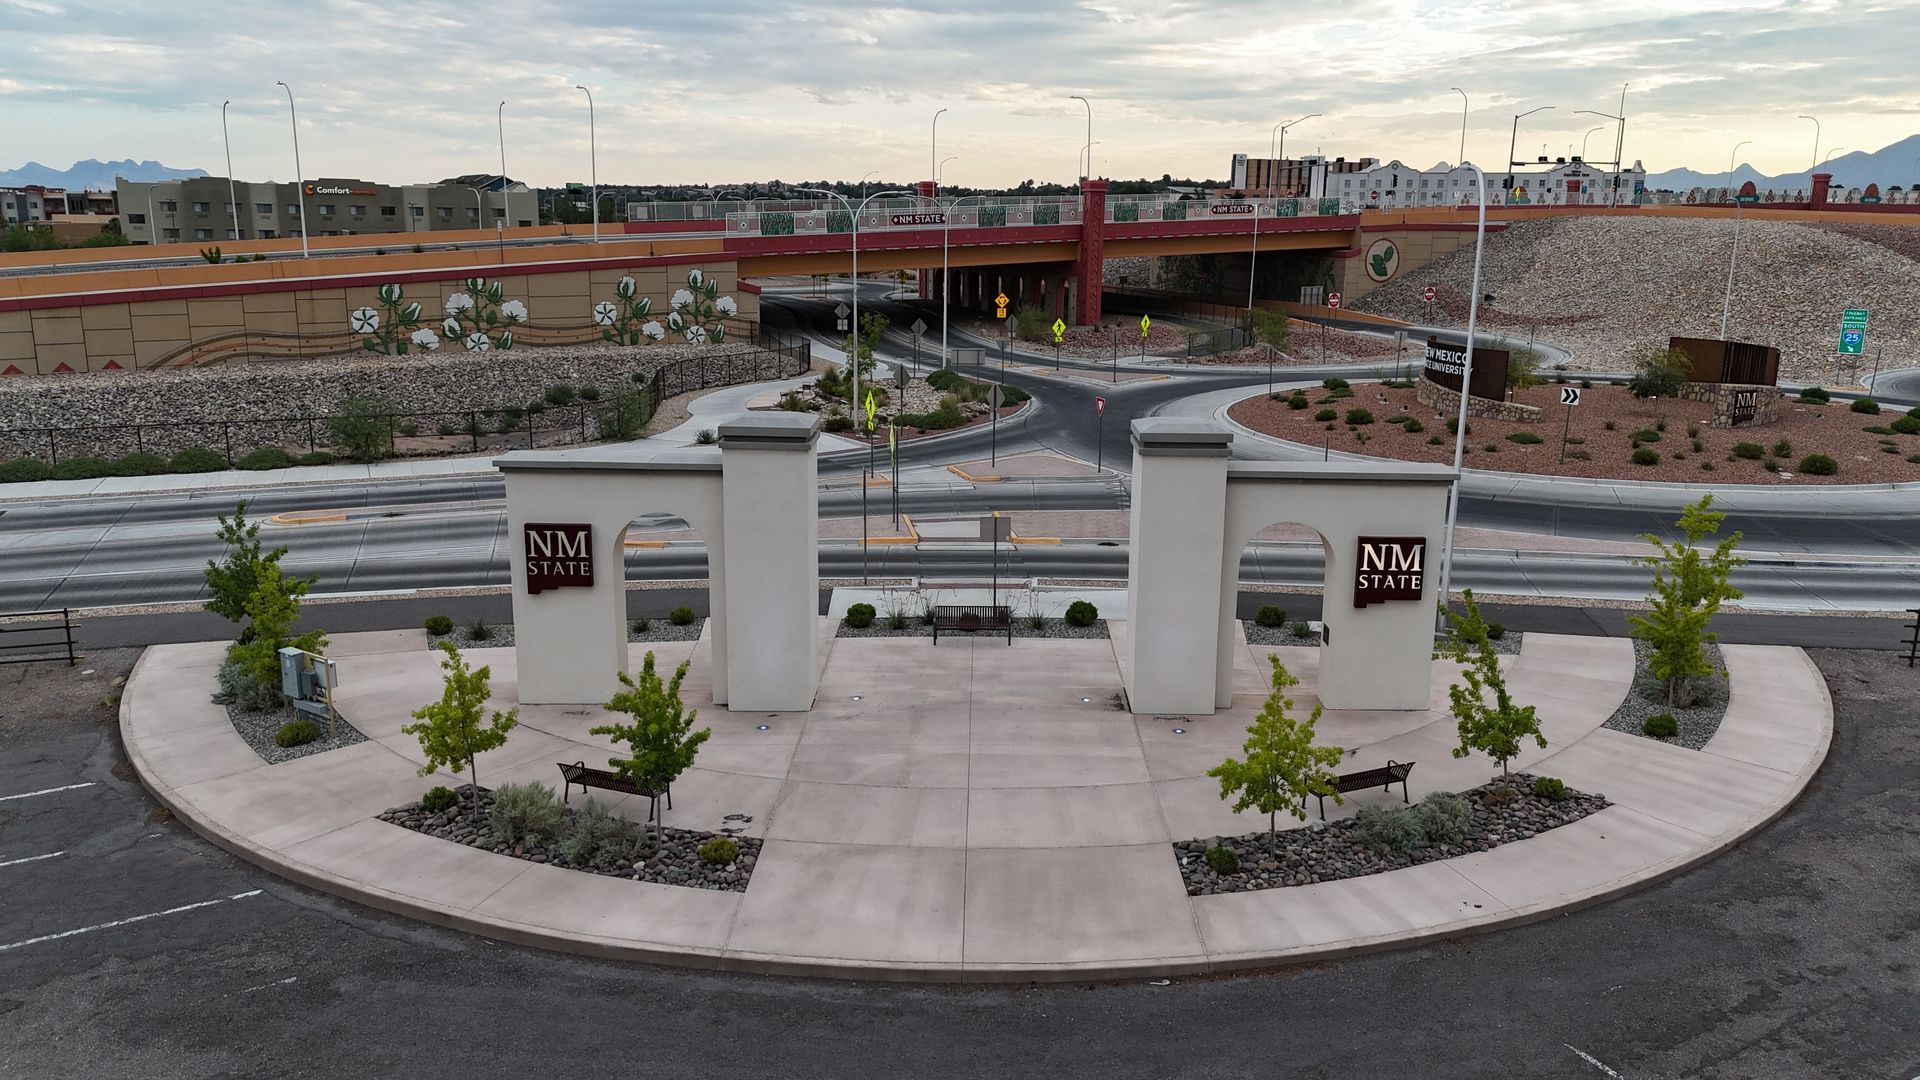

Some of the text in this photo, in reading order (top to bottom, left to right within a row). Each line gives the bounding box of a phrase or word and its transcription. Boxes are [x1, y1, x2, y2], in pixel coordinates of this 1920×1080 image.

[316, 186, 350, 194] Comfort
[1217, 205, 1249, 213] NM STATE
[899, 214, 941, 224] NM STATE
[1846, 333, 1859, 342] 25
[1425, 346, 1436, 359] EW
[1736, 392, 1757, 407] NM
[1735, 407, 1755, 416] STATE
[526, 530, 589, 558] NM
[1360, 543, 1424, 571] NM
[528, 561, 590, 576] STATE
[1358, 574, 1422, 590] STATE
